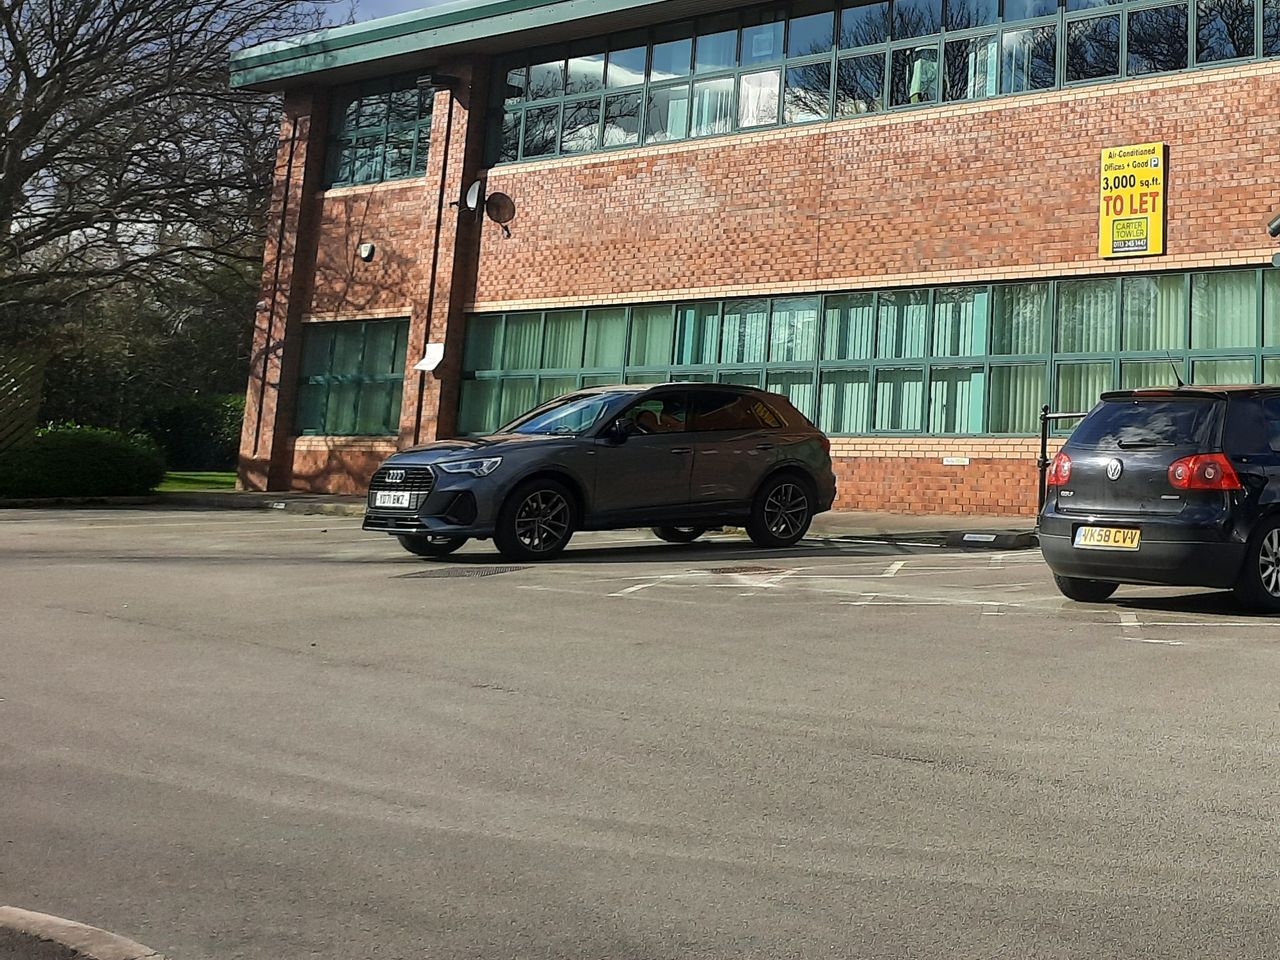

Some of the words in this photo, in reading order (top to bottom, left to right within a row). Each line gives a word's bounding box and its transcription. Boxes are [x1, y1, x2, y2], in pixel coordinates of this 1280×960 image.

[1108, 147, 1156, 159] Air-Conditioned
[1104, 163, 1125, 171] Offices
[1132, 159, 1149, 168] Good
[1103, 174, 1136, 192] 3,000
[1140, 177, 1161, 188] sq.ft.
[1103, 194, 1124, 216] TO
[1130, 191, 1159, 214] LET
[1116, 222, 1142, 230] CARTER
[1116, 230, 1144, 238] TOWLER
